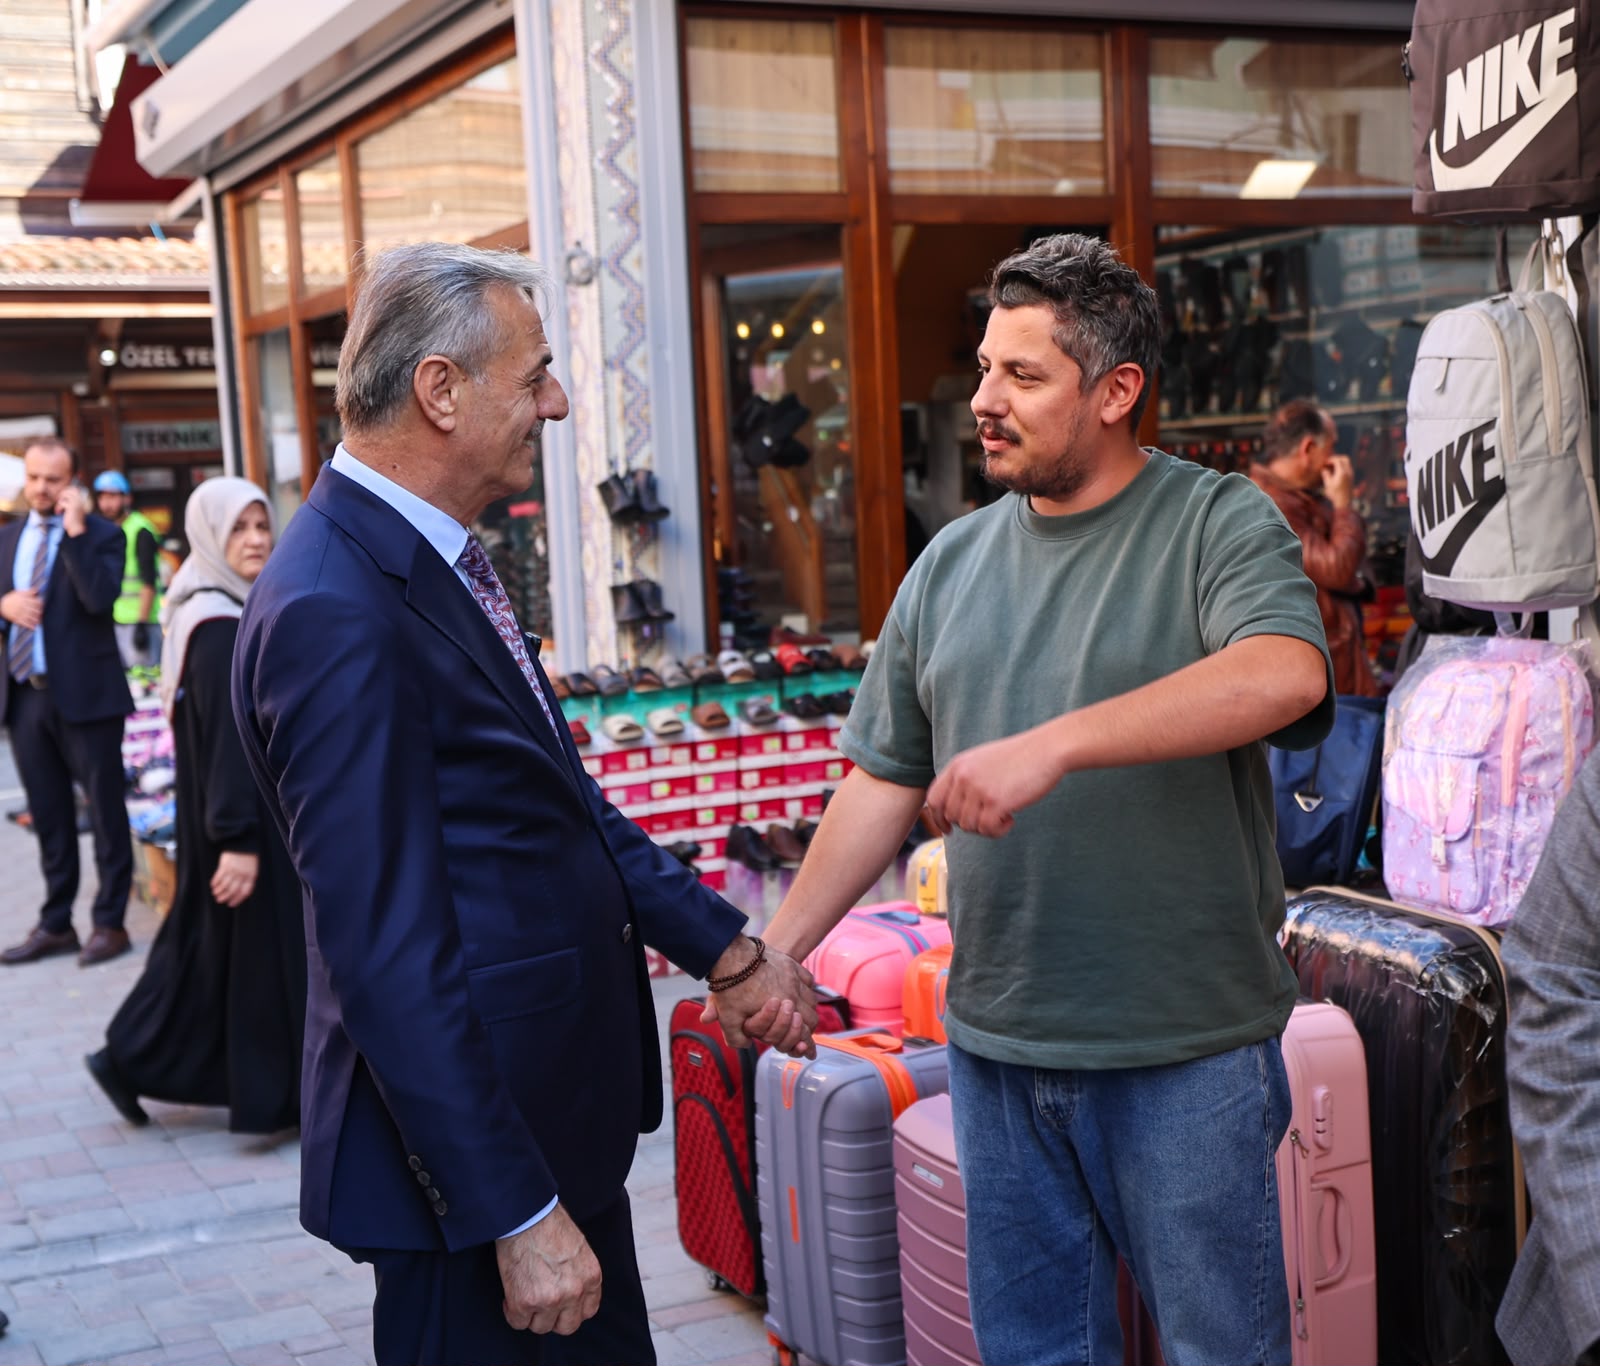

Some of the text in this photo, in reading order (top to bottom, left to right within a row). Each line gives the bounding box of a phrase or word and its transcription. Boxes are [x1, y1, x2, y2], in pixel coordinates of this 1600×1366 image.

[1442, 7, 1577, 154] NIKE
[120, 342, 181, 368] ÖZEL
[1416, 416, 1502, 539] NIKE
